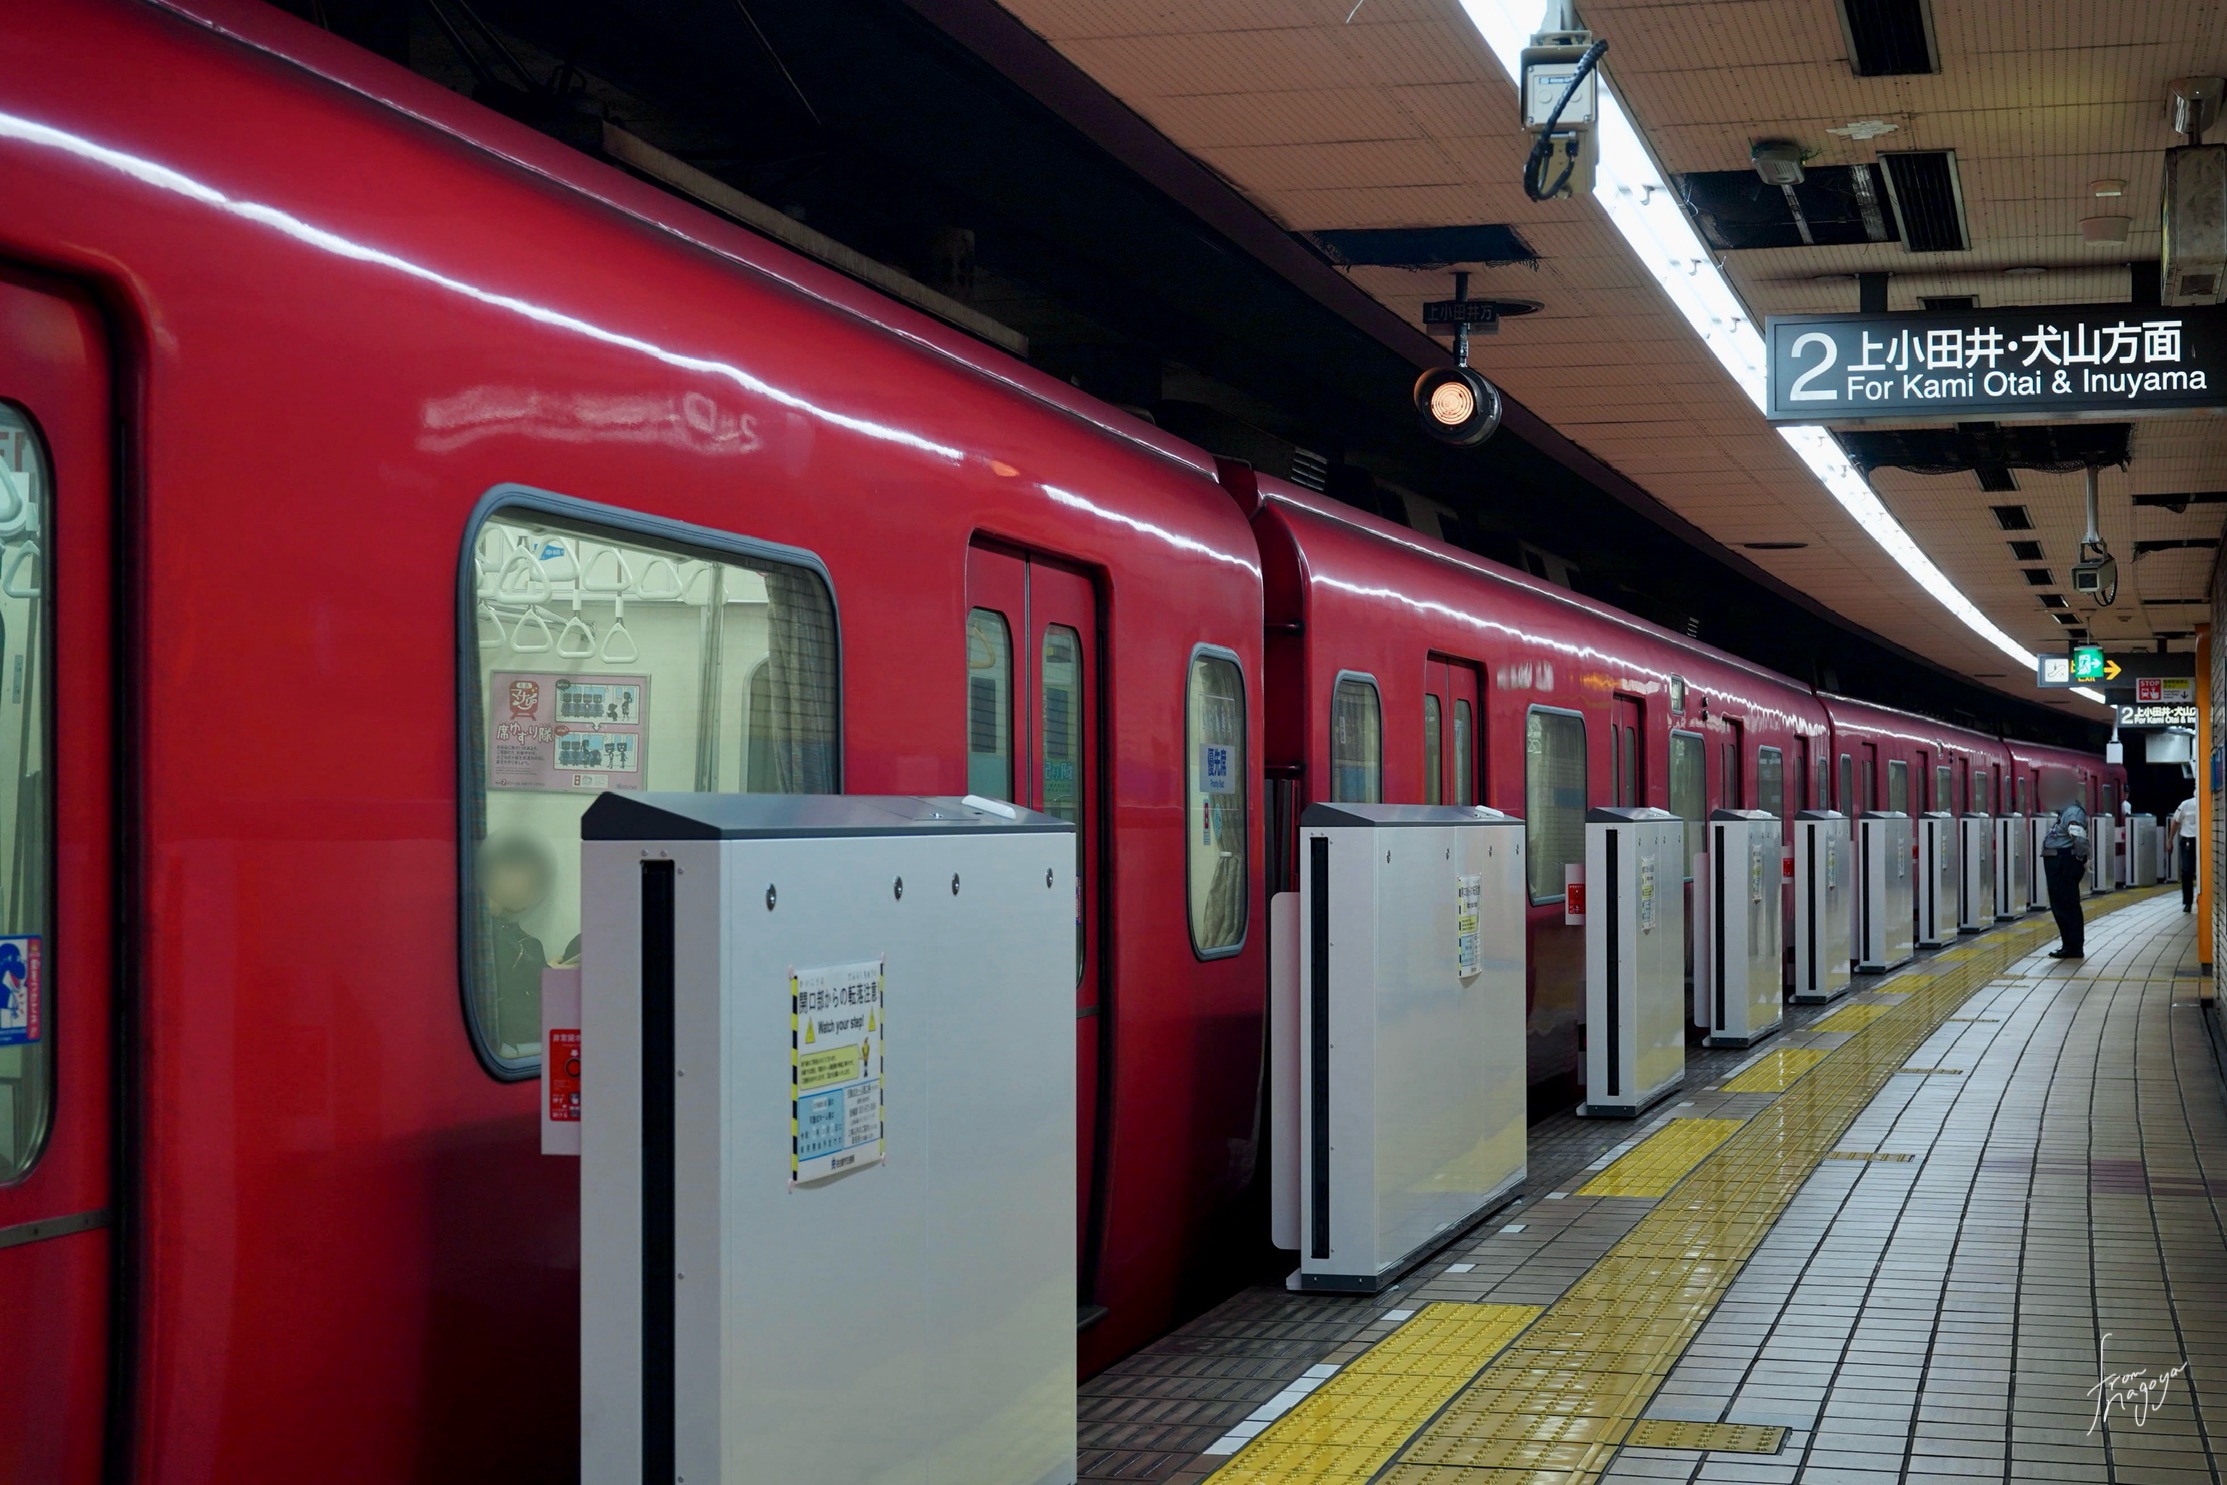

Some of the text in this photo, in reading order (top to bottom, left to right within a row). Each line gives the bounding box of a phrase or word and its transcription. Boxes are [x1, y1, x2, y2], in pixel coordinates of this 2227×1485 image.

[1427, 303, 1493, 321] 上小田井方
[1847, 320, 2183, 373] 上小田井・犬山方面
[1789, 332, 1839, 402] 2
[1848, 368, 2207, 401] For Kami Otai & Inuyama
[2121, 706, 2134, 724] 2
[2134, 716, 2146, 725] For
[2147, 716, 2164, 725] Kami
[2165, 716, 2180, 724] Otai
[1208, 748, 1227, 776] 優先席
[818, 1014, 865, 1035] Watch your step!
